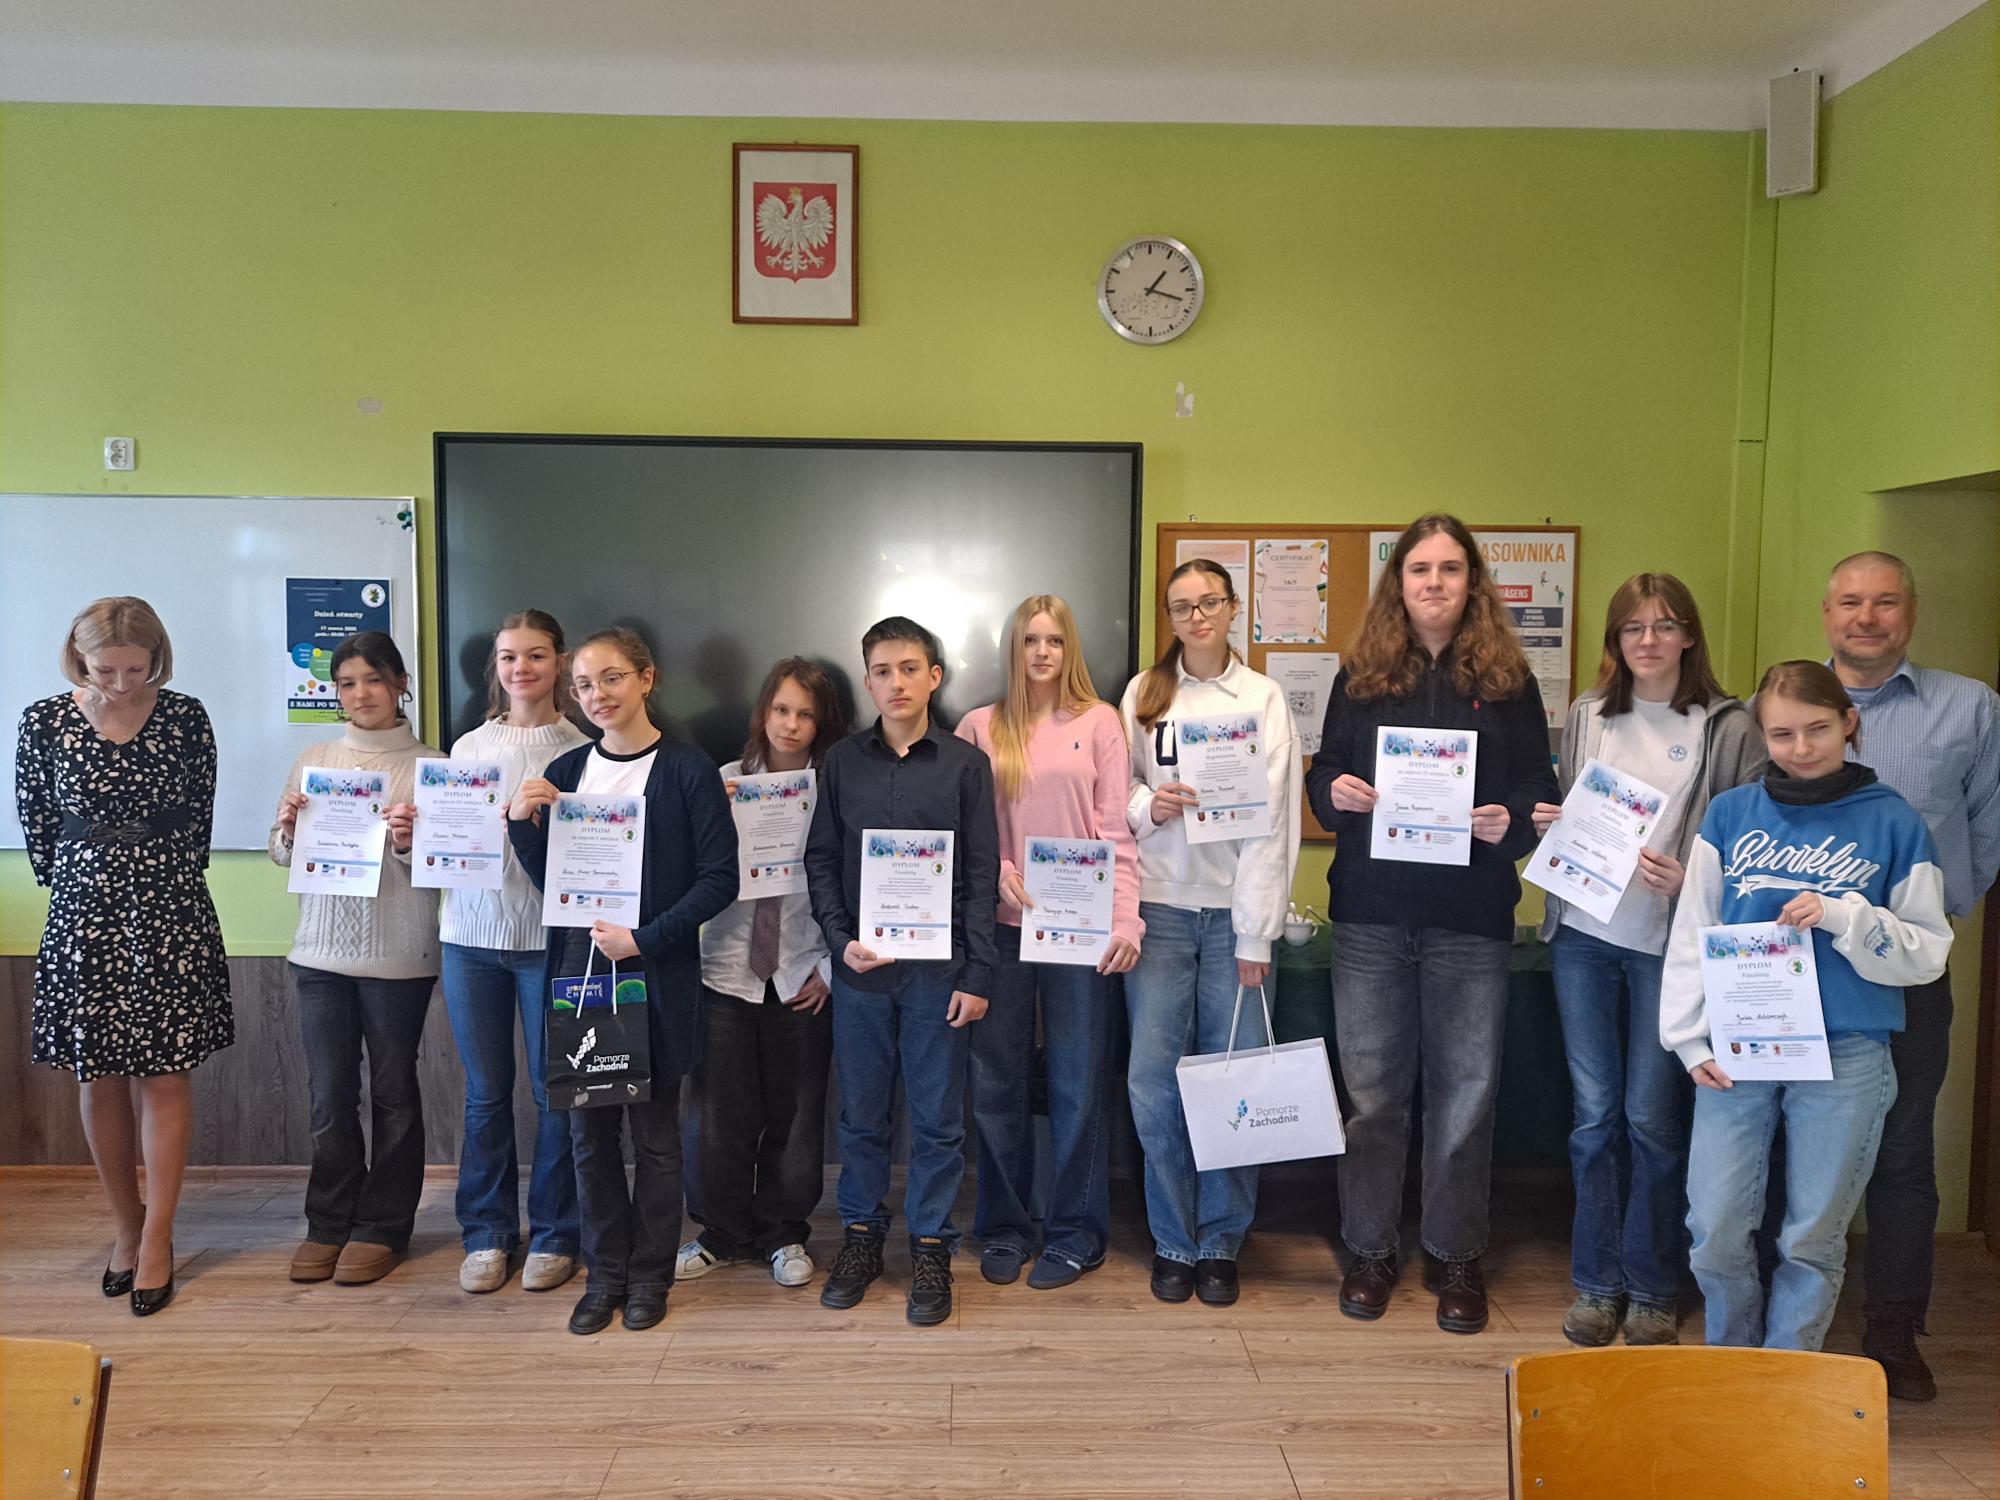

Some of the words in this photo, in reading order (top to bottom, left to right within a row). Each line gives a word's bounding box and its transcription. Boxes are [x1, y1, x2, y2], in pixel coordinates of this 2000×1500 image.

[1479, 542, 1566, 562] ASOWNIKA
[336, 611, 363, 620] otwarty
[296, 700, 316, 708] NAMI
[1207, 745, 1234, 753] DYPLOM
[1601, 802, 1630, 820] DYPLOM
[1724, 829, 1881, 890] Brooklyn
[1737, 961, 1772, 970] DYPLOM
[566, 989, 603, 998] CHMIĘ
[593, 1053, 630, 1064] Pomorze
[586, 1061, 629, 1073] Zachodnie
[1255, 1103, 1300, 1117] Pomorze
[1249, 1114, 1299, 1128] Zachodnie
